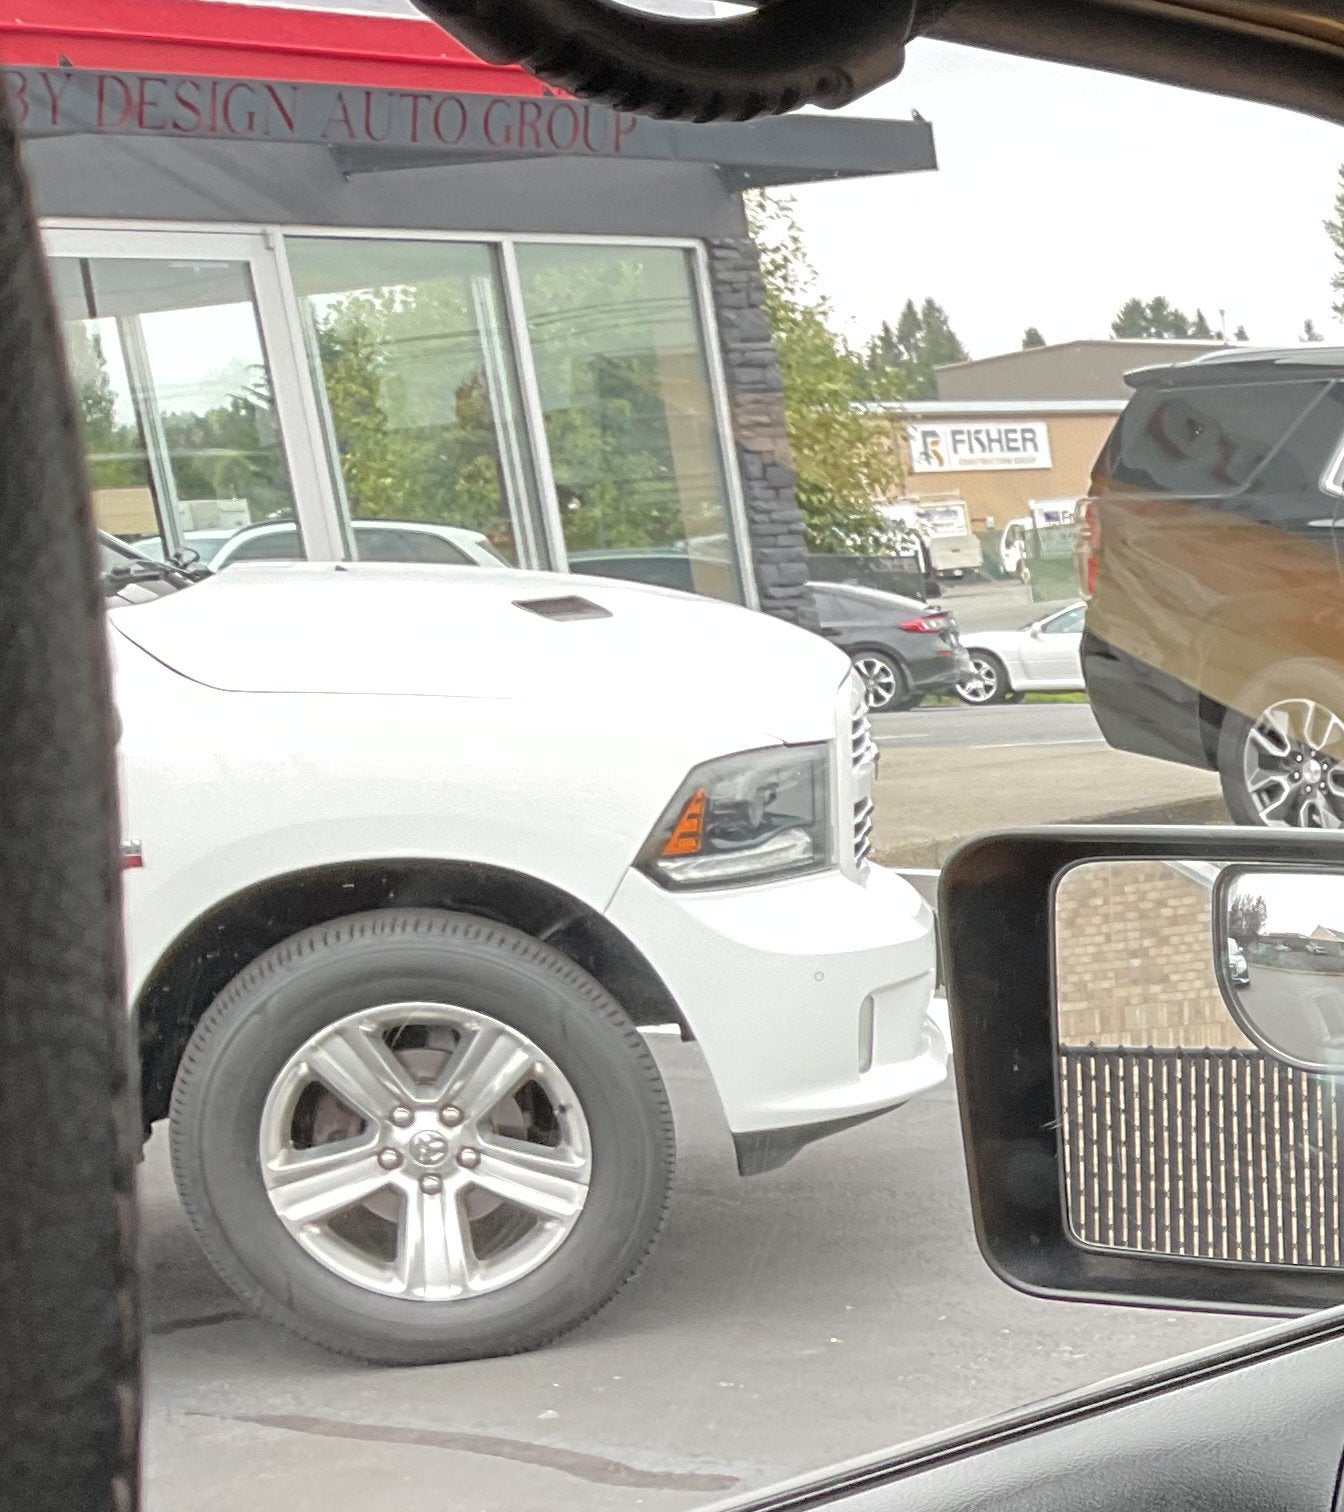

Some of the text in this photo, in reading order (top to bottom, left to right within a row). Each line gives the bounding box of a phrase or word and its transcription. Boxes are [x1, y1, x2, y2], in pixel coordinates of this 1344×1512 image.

[97, 75, 299, 136] DESIGN
[320, 91, 468, 144] AUTO
[483, 99, 637, 152] GROUP
[951, 427, 1039, 454] FISHER
